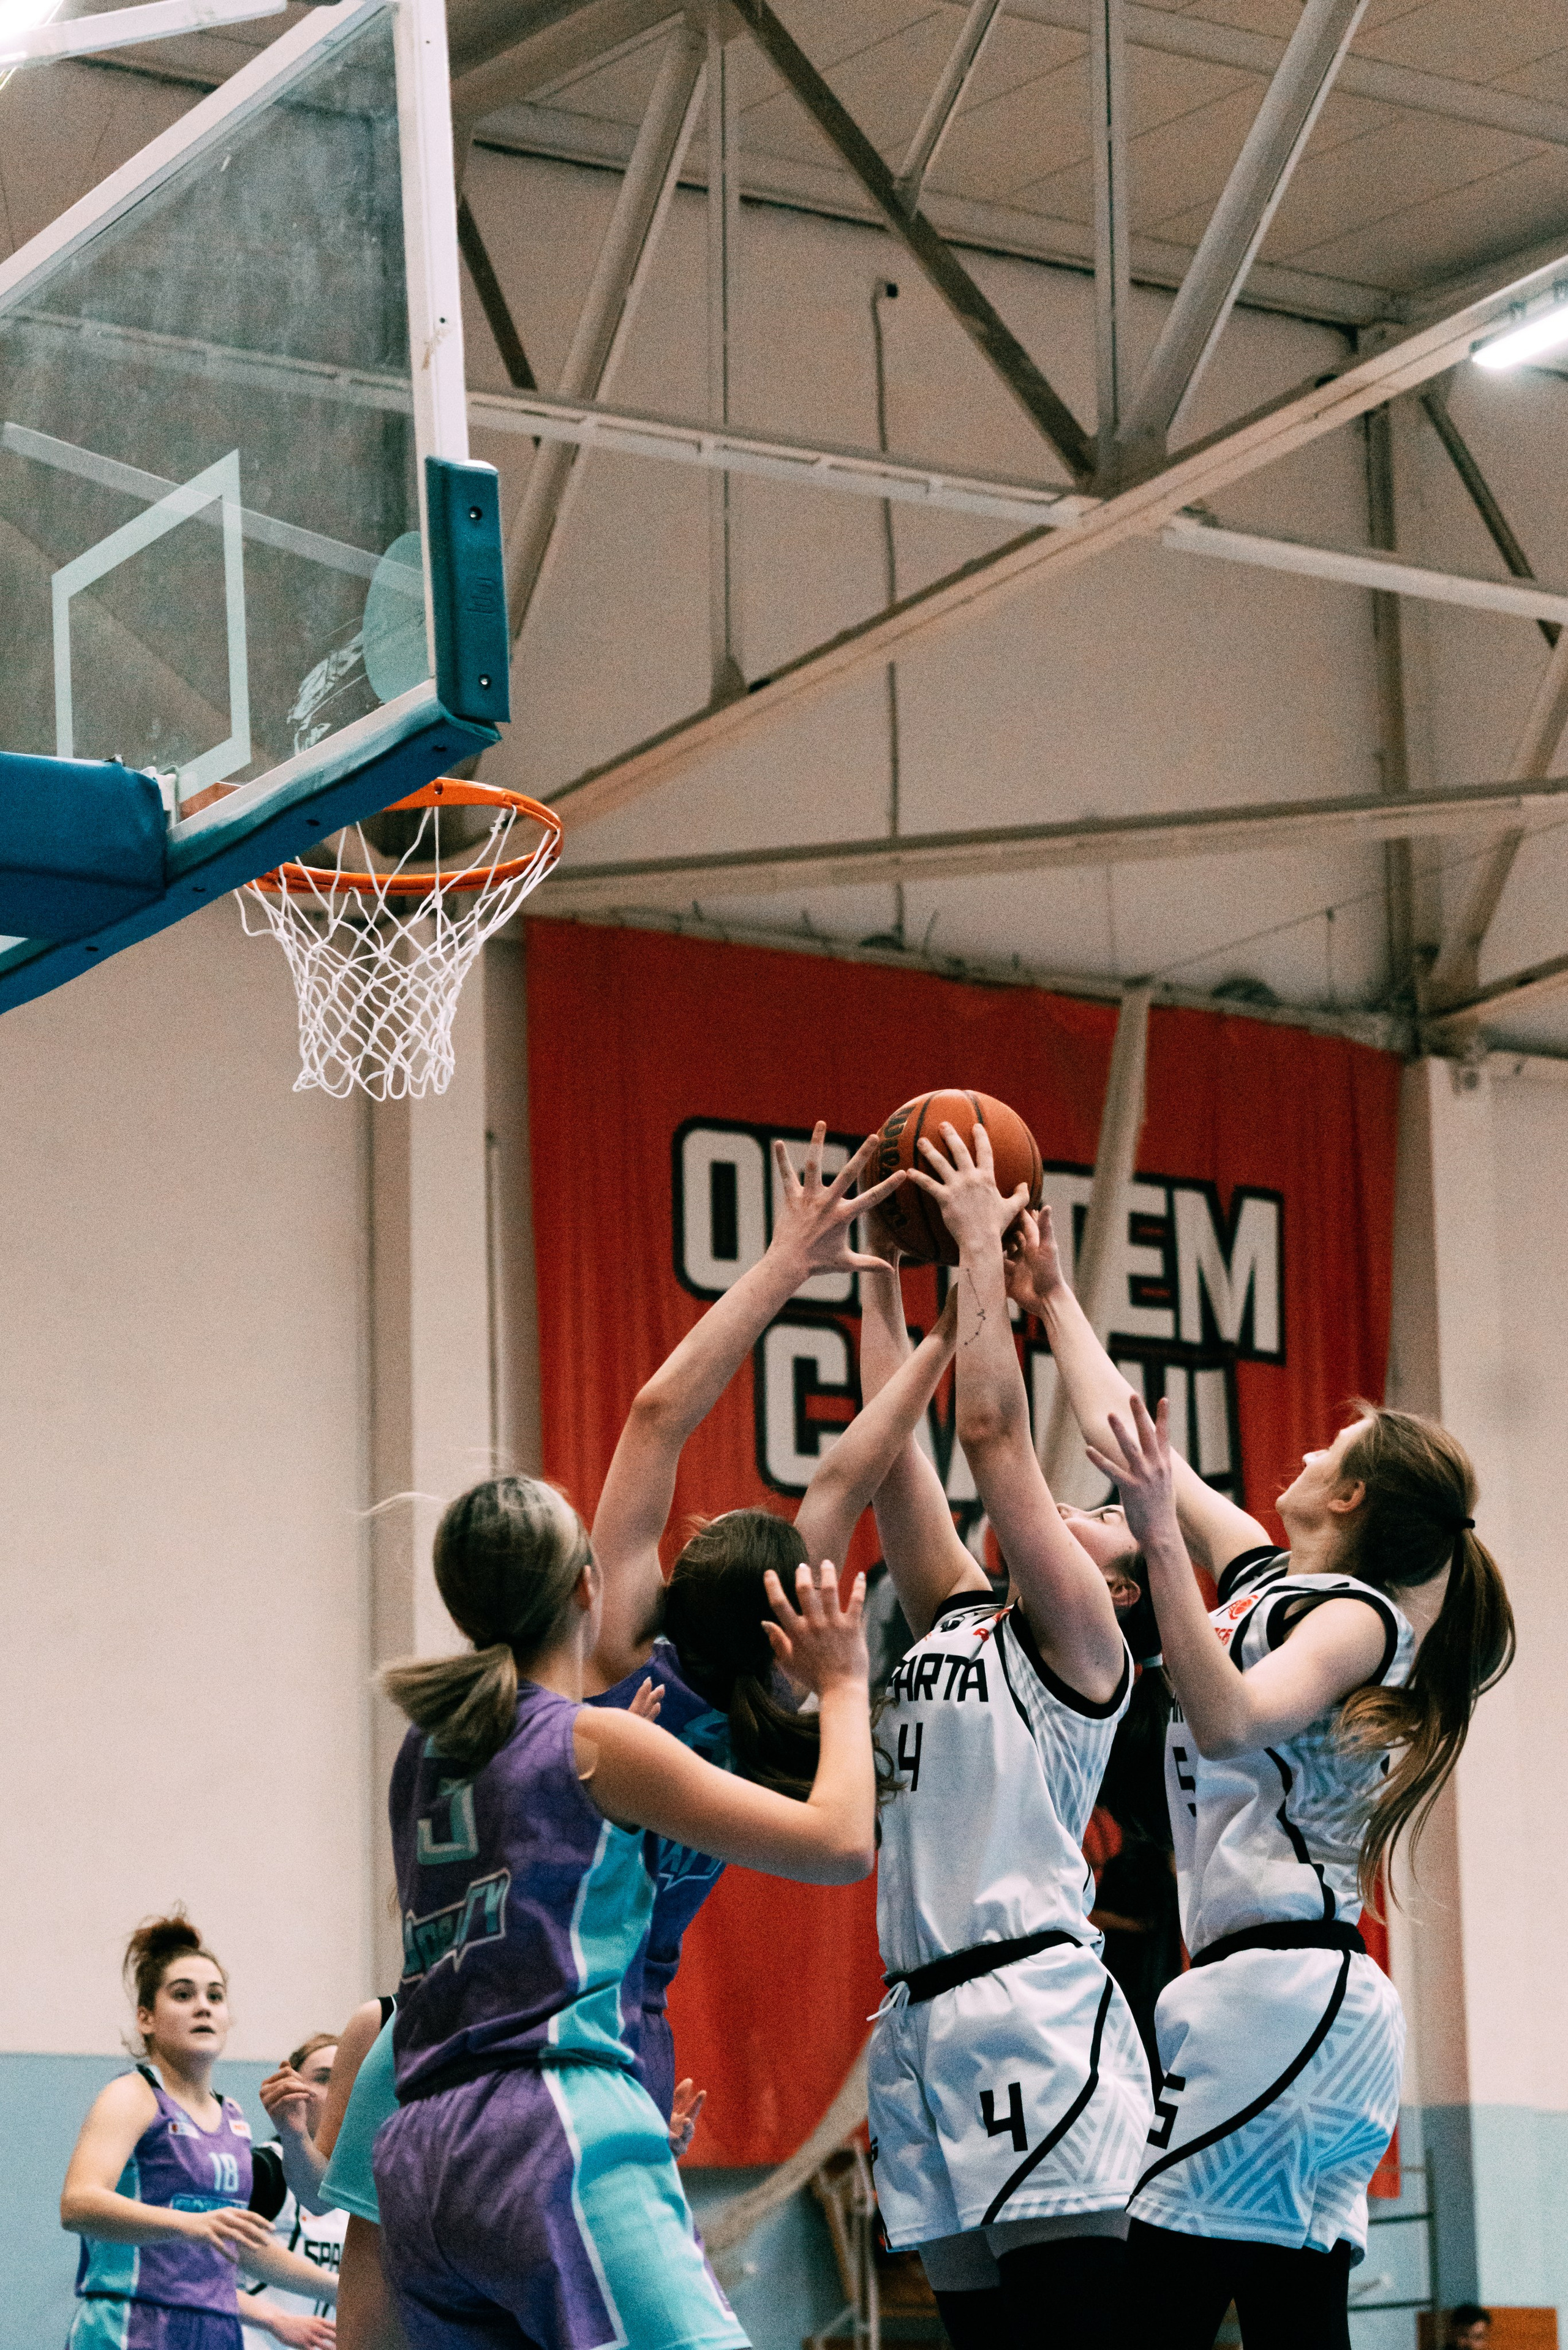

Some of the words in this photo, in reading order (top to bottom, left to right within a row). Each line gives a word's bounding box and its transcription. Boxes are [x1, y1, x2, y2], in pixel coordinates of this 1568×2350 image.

[892, 1654, 989, 1703] ARTA
[897, 1723, 922, 1791] 4
[981, 2082, 1028, 2152] 4
[1147, 2074, 1185, 2149] 5
[209, 2152, 239, 2193] 18
